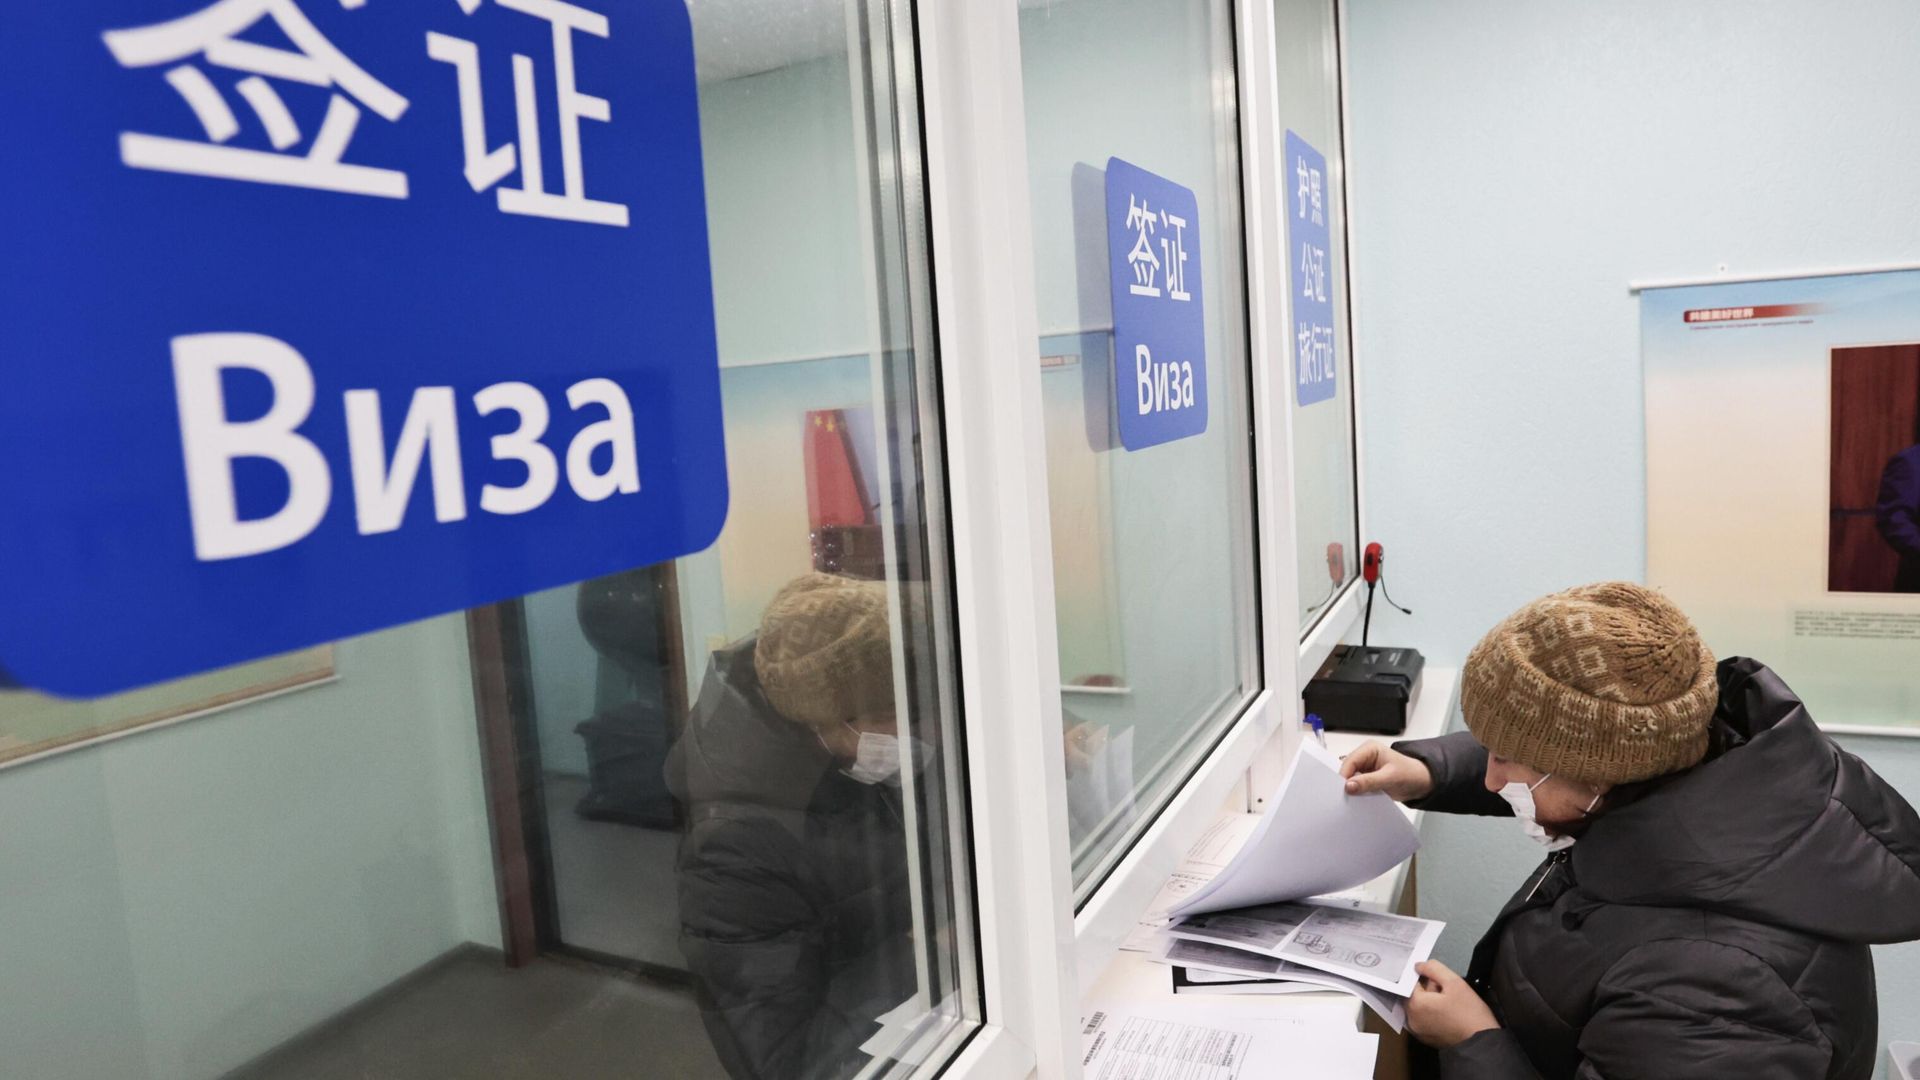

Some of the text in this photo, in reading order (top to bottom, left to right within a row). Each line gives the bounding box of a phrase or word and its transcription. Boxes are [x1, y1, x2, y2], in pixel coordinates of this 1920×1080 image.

[1297, 155, 1324, 227] 护照
[1126, 193, 1191, 301] 签证
[1301, 241, 1327, 302] 公证
[1135, 344, 1195, 415] Виза
[1298, 321, 1335, 385] 旅行证
[170, 331, 641, 561] Виза
